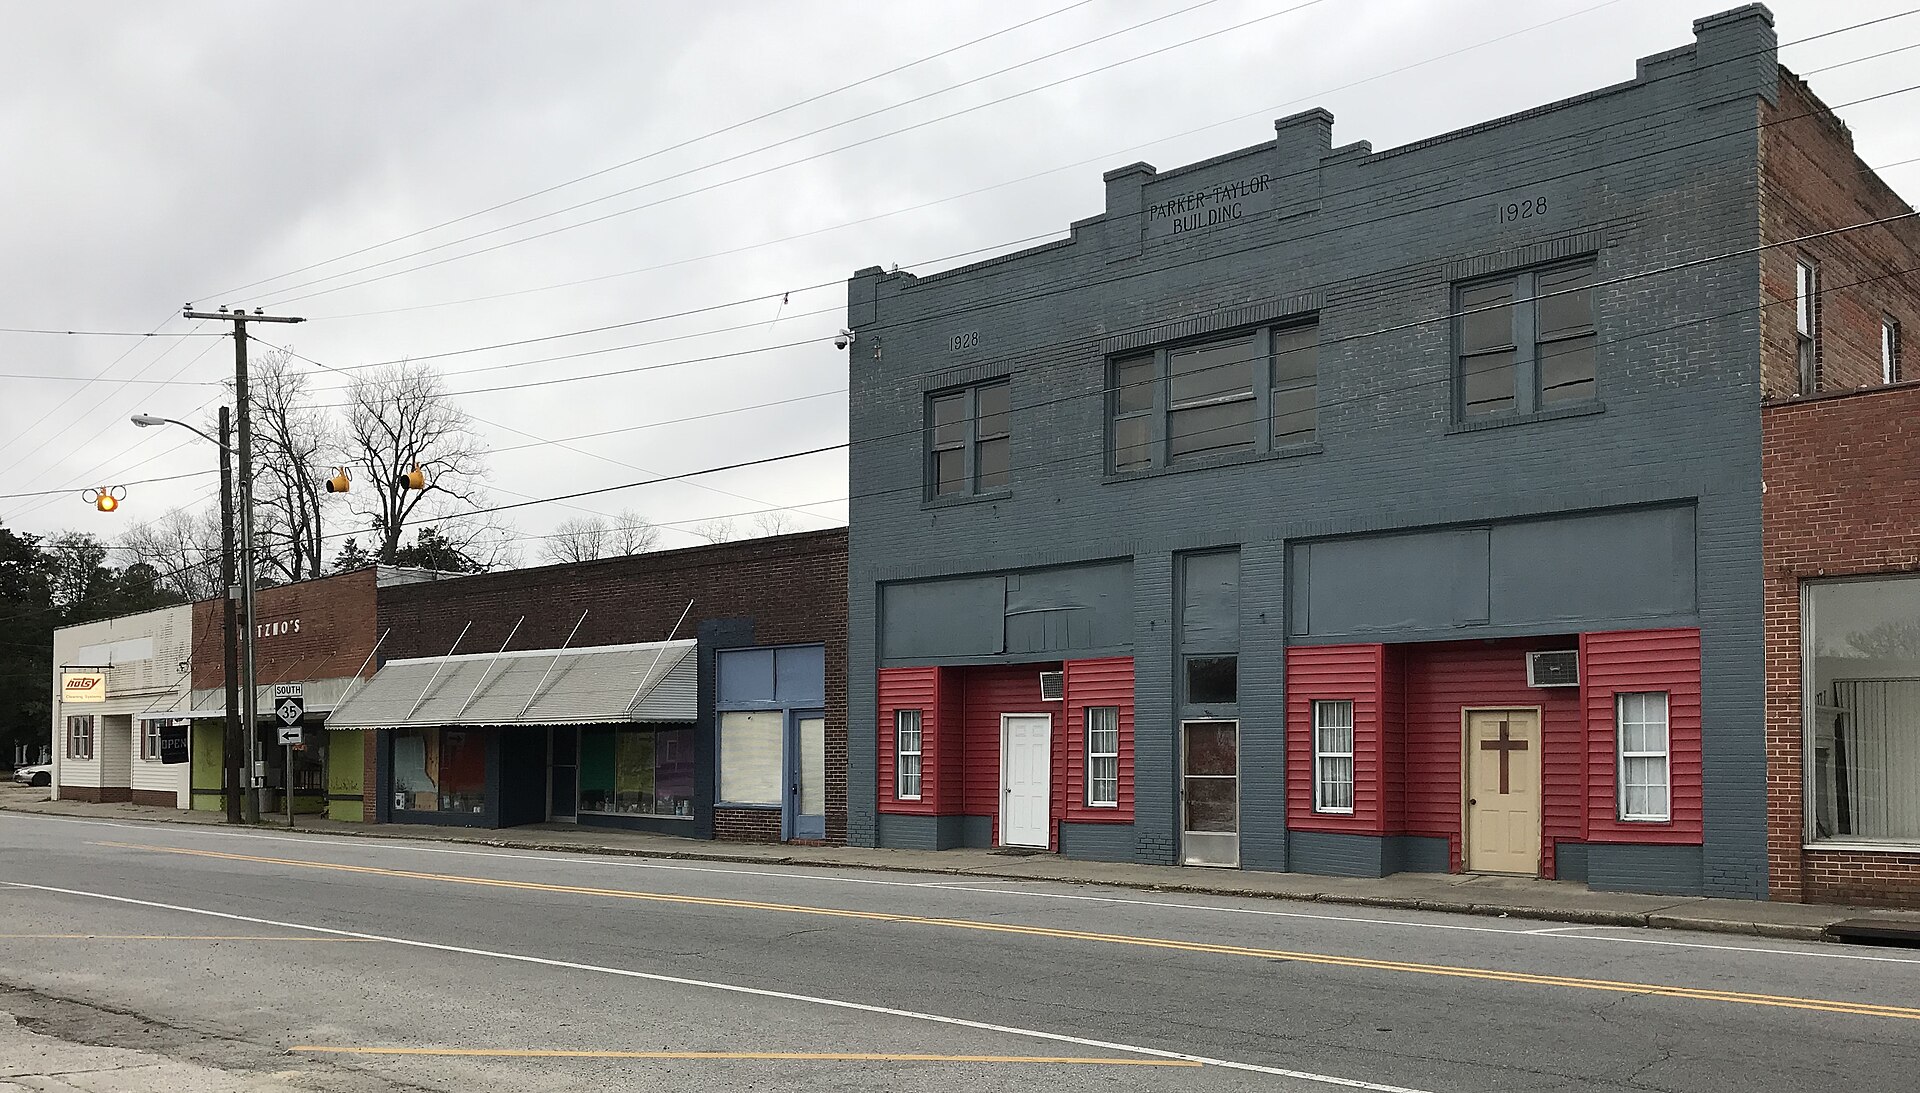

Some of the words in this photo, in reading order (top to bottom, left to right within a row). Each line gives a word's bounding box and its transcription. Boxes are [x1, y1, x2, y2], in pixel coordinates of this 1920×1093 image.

[1150, 174, 1270, 221] PARKER-TAYLOR
[1173, 202, 1243, 234] BUILDING
[1499, 196, 1547, 224] 1928
[949, 331, 979, 352] 1928
[276, 685, 301, 695] SOUTH
[282, 705, 297, 719] 35
[162, 738, 187, 749] OPEN
